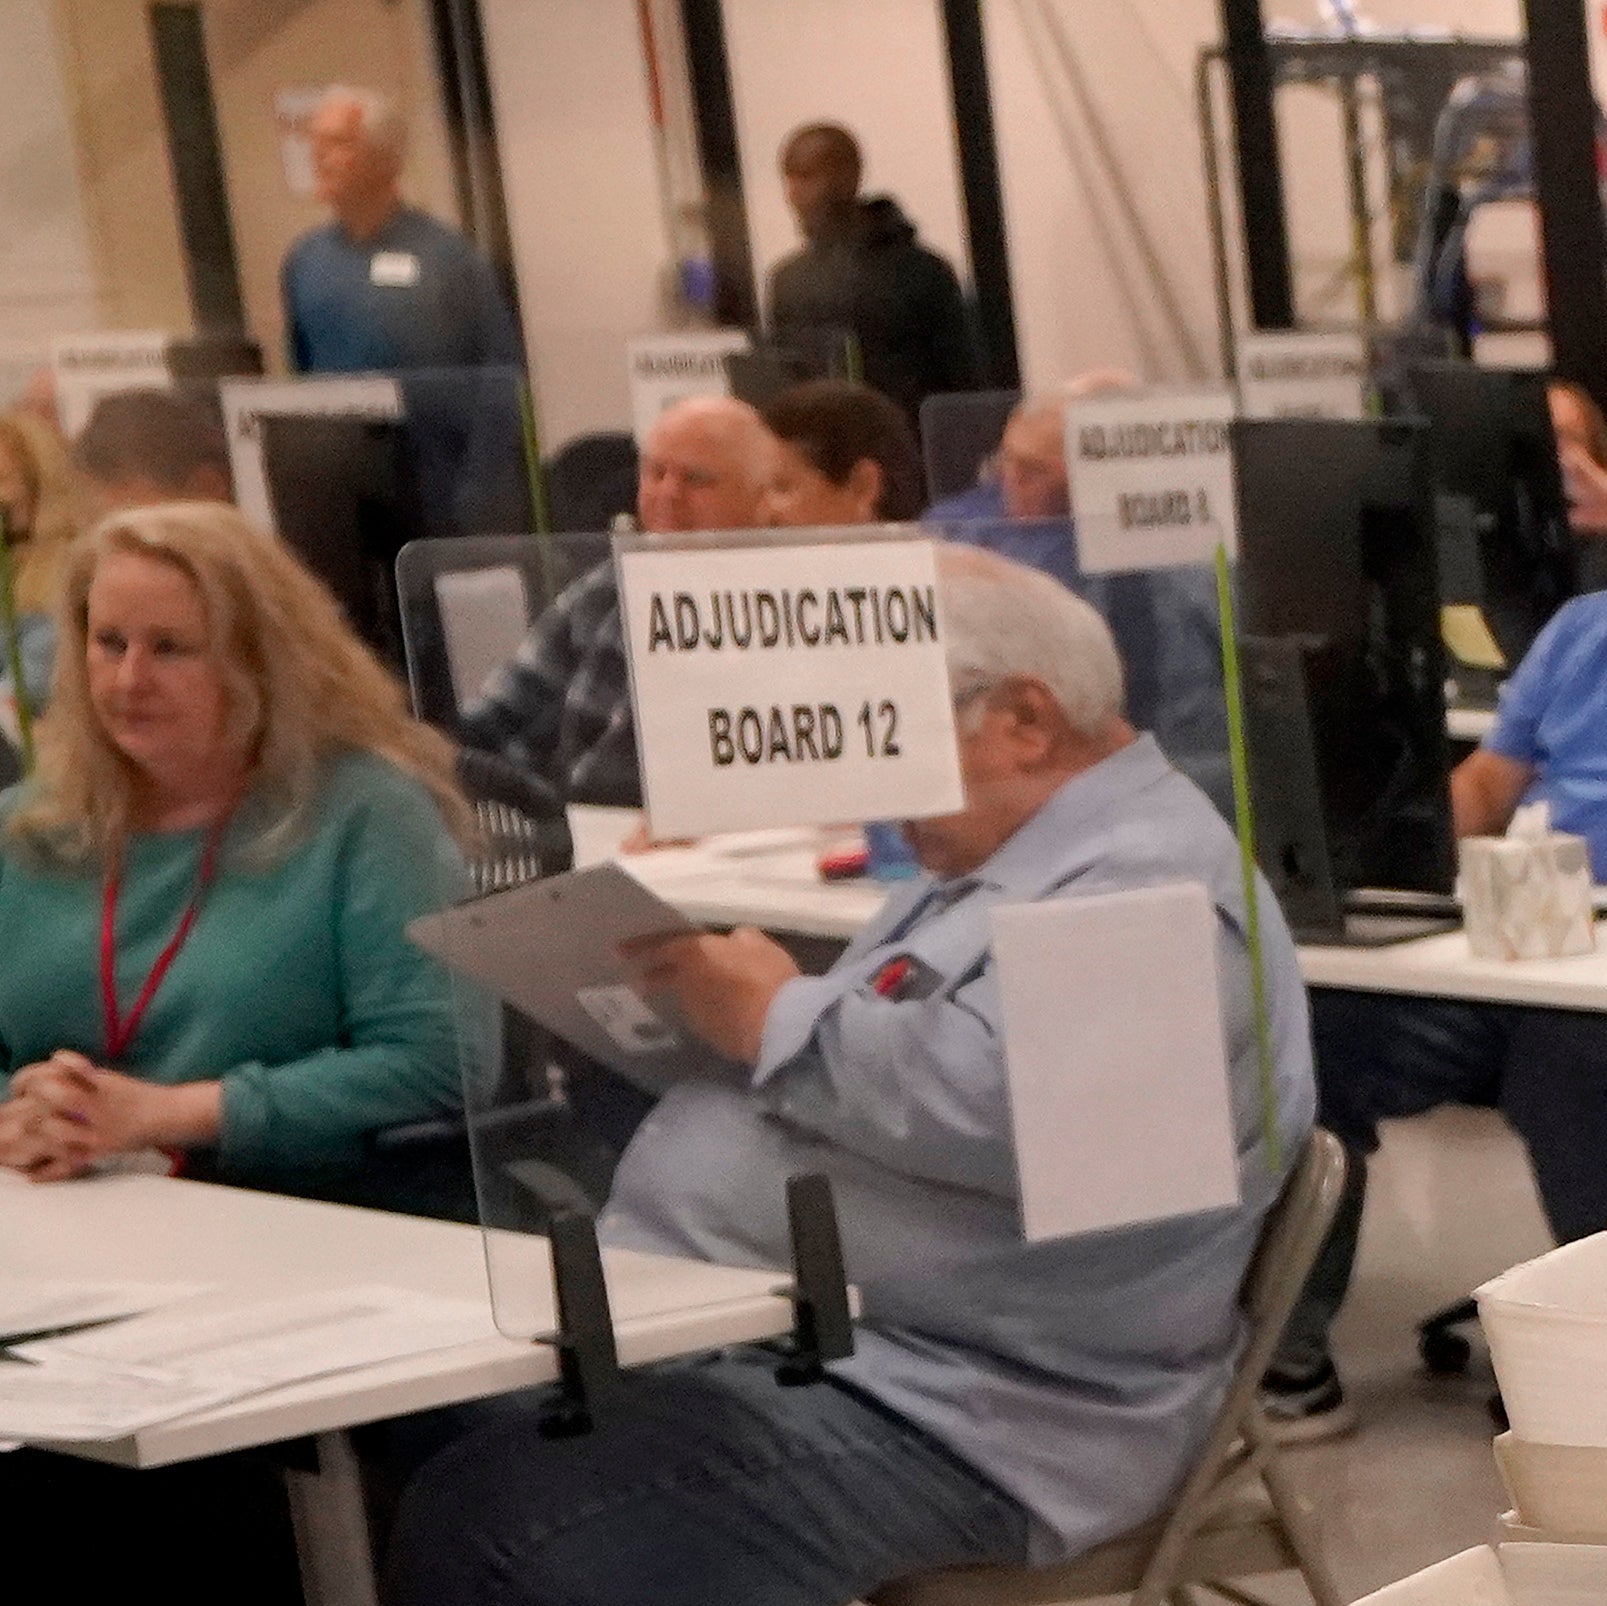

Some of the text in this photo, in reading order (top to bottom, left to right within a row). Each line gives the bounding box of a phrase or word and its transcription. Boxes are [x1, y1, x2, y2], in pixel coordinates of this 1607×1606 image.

[648, 584, 939, 653] ADJUDICATION
[707, 698, 901, 768] BOARD 12
